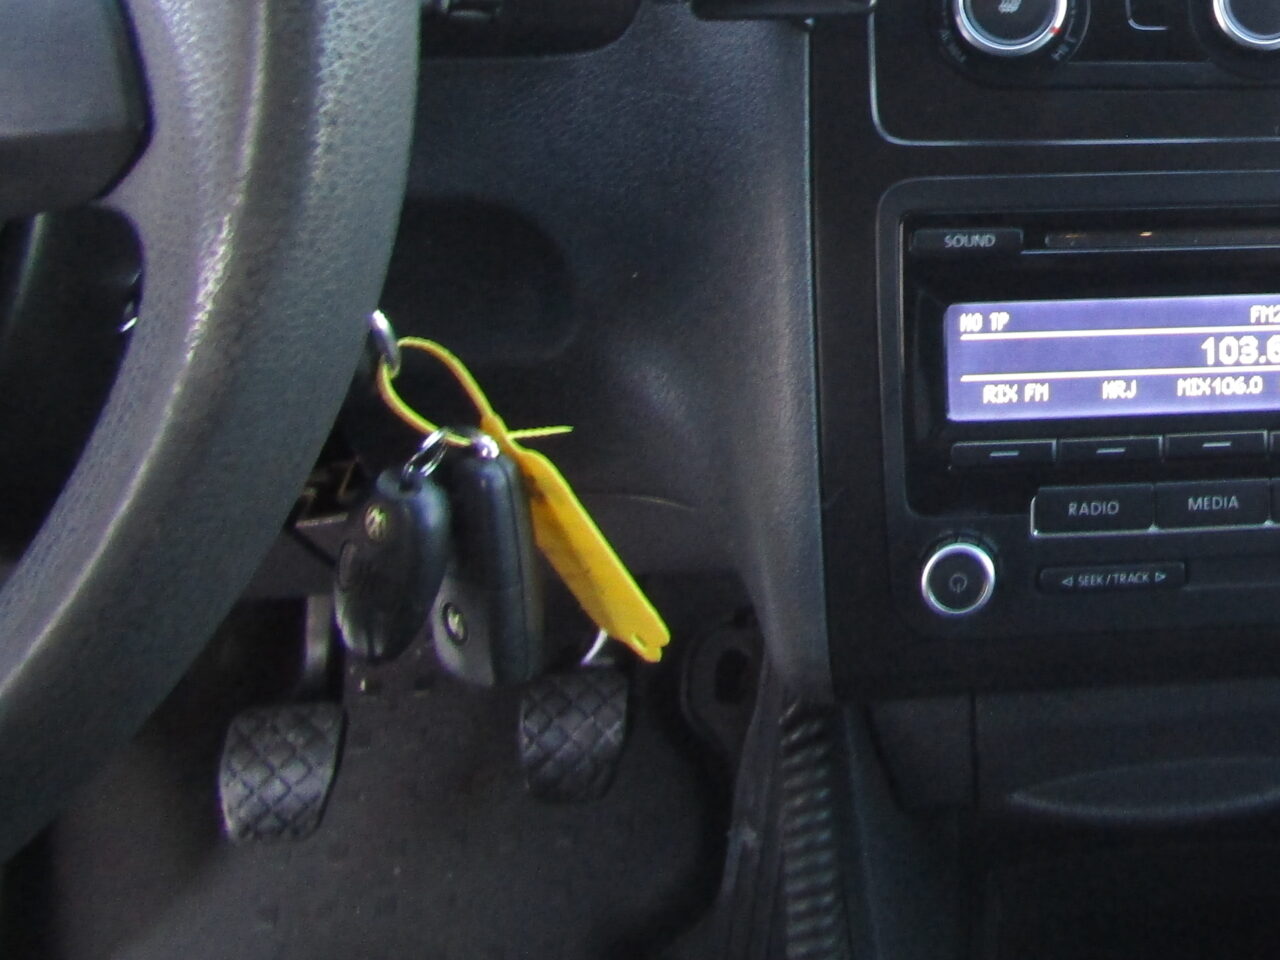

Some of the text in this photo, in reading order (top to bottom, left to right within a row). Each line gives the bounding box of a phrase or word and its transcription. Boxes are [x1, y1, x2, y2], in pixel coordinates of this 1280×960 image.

[943, 233, 997, 249] SOUND
[959, 311, 1010, 332] NO TP
[982, 382, 1050, 404] RIX FM
[1101, 379, 1138, 400] NRJ
[1067, 500, 1120, 517] RADIO
[1187, 494, 1240, 512] MEDIA
